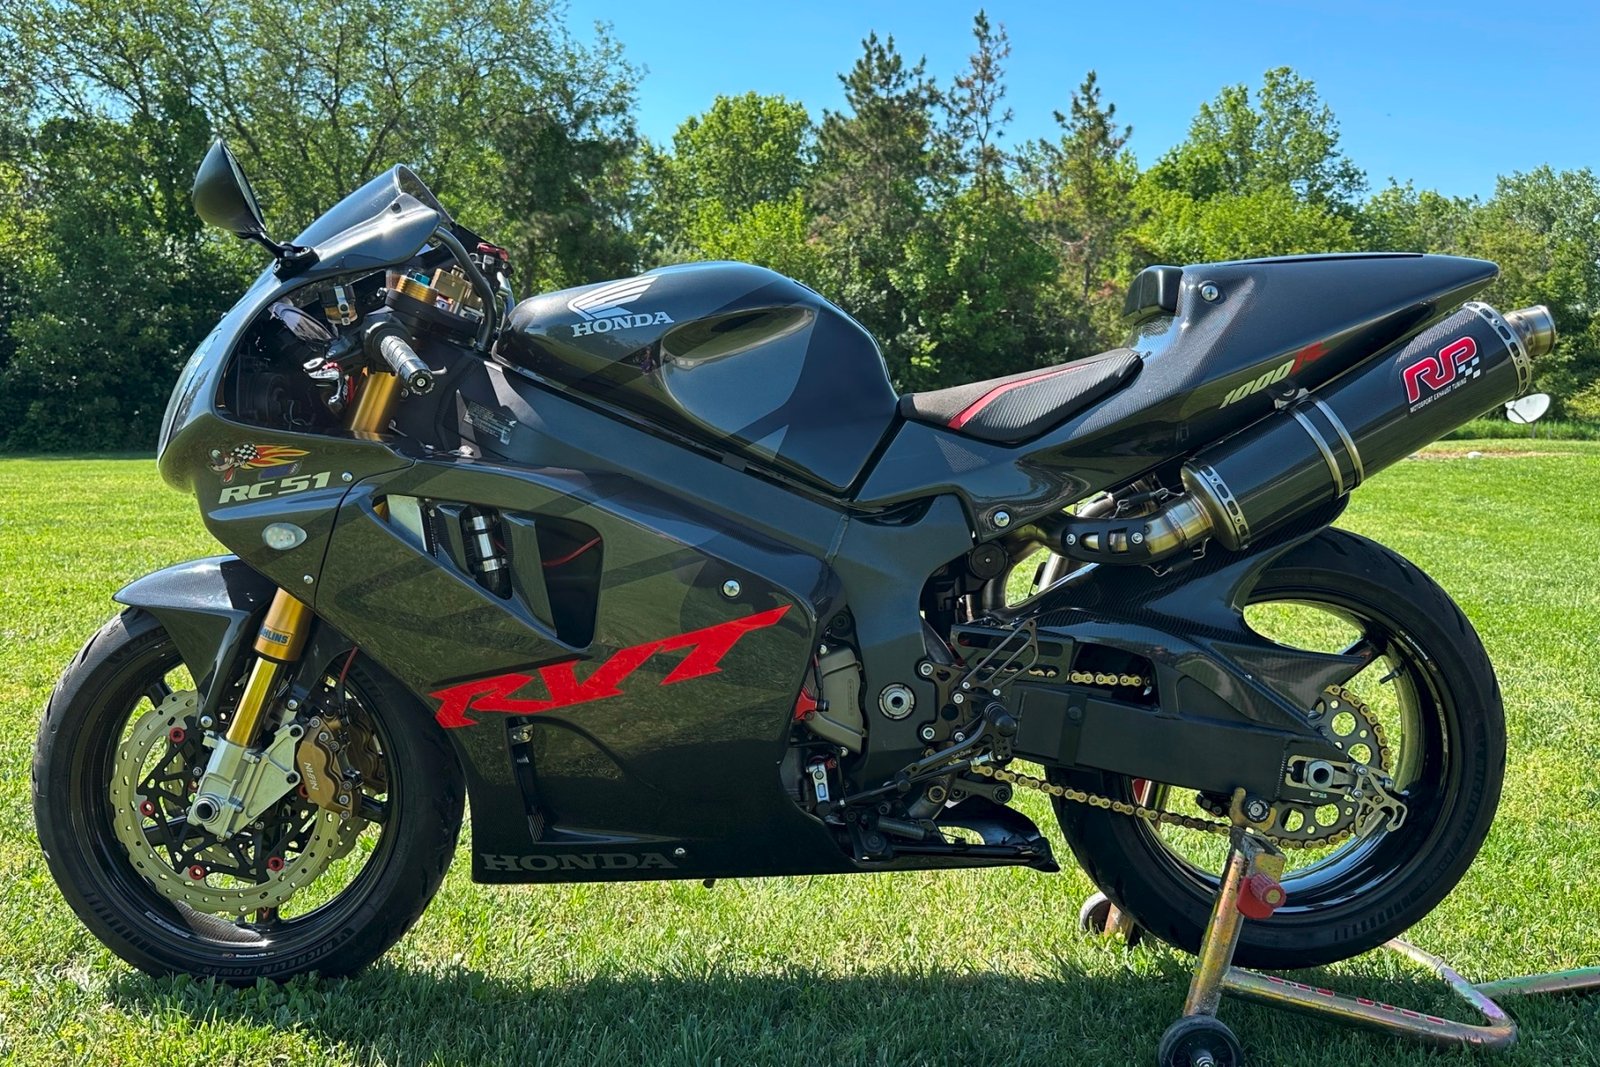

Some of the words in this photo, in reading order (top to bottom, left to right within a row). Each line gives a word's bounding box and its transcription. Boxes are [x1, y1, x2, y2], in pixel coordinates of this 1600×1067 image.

[571, 311, 675, 337] HONDA
[428, 604, 793, 729] RVT
[480, 853, 678, 871] HONDA
[262, 940, 334, 973] MICHELIN
